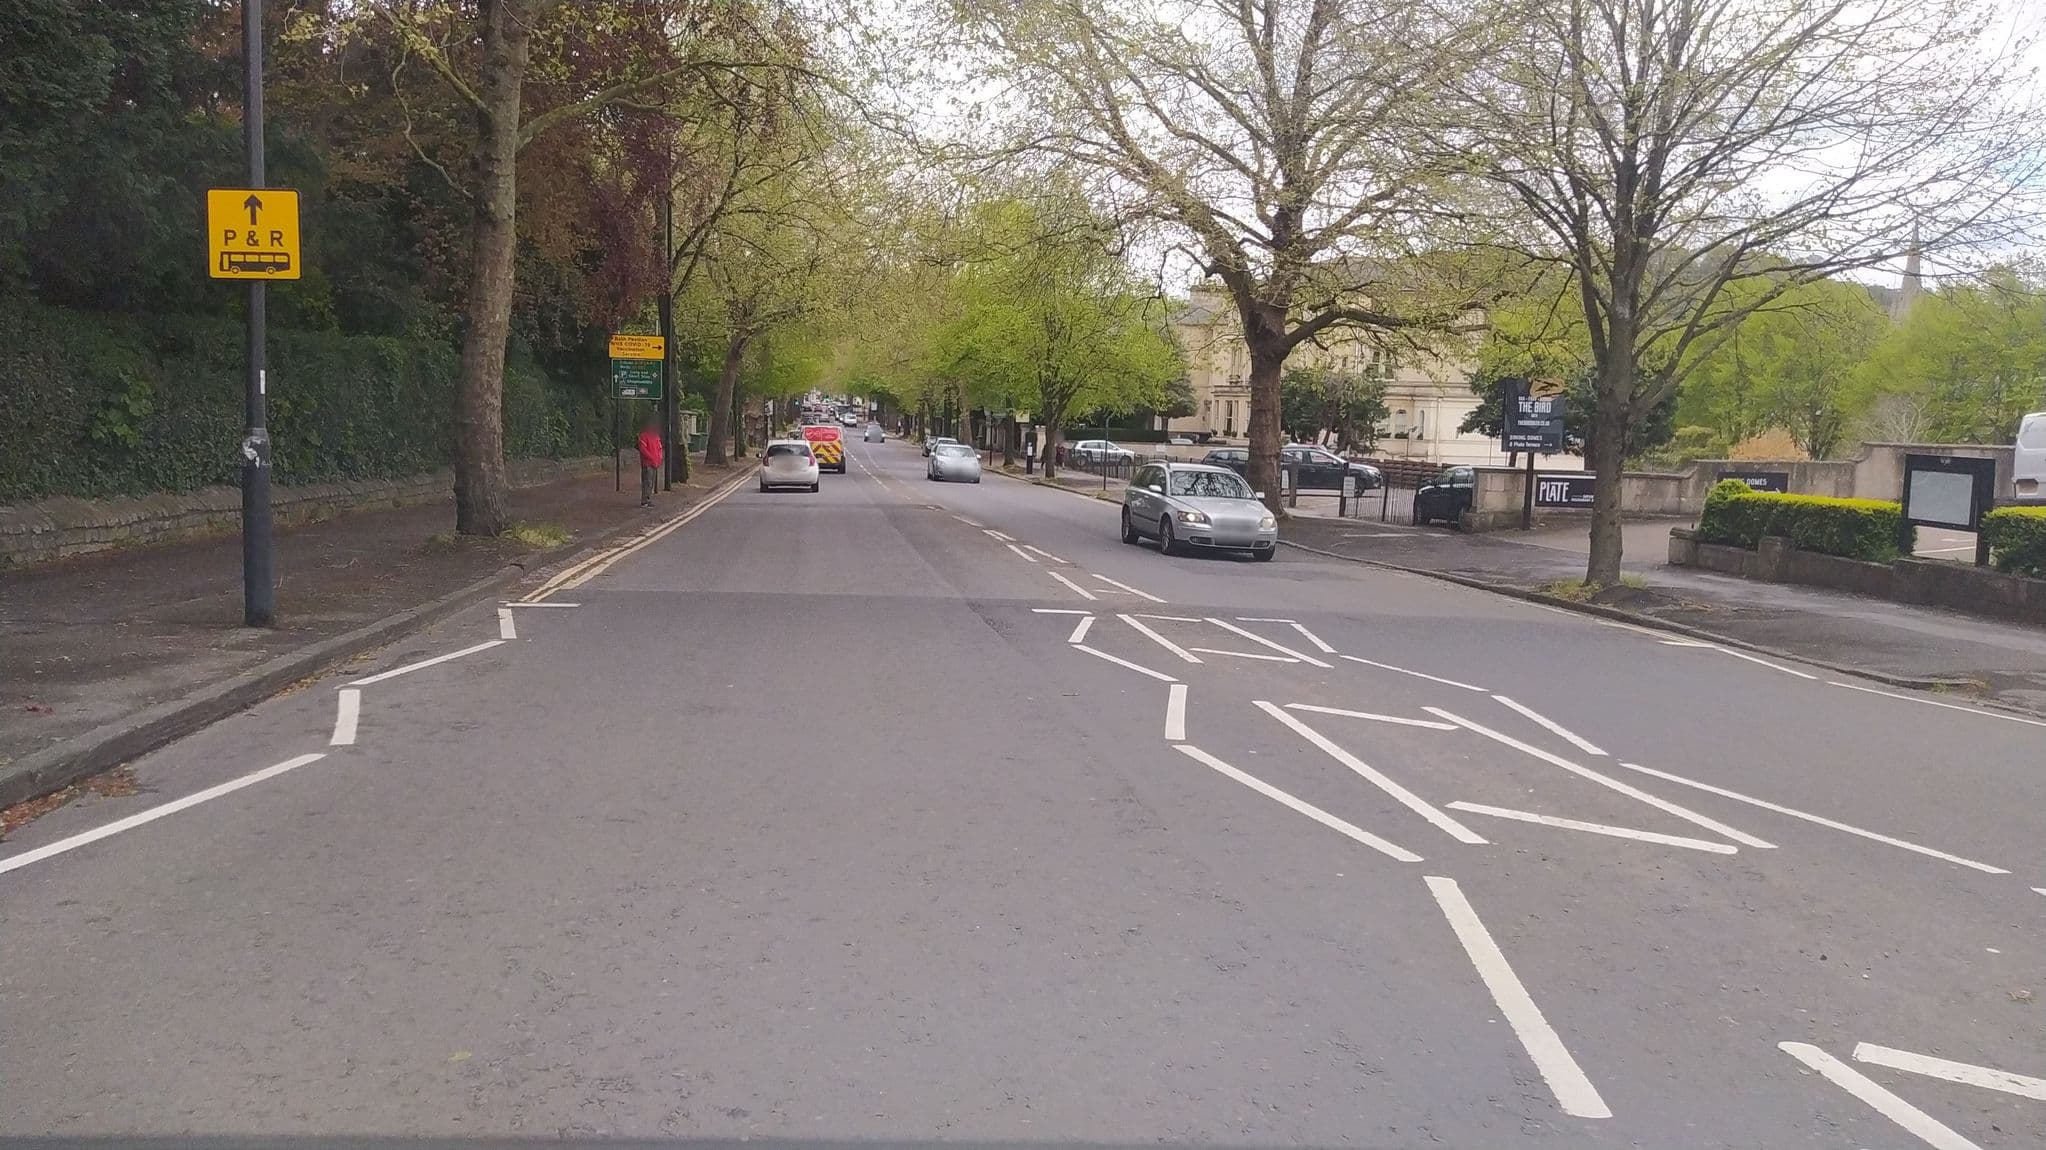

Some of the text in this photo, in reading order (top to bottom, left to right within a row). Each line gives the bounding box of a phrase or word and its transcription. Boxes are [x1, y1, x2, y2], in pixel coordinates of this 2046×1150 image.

[223, 229, 283, 247] P & R
[1518, 401, 1552, 413] THE BIRD
[1539, 481, 1570, 502] PLATE
